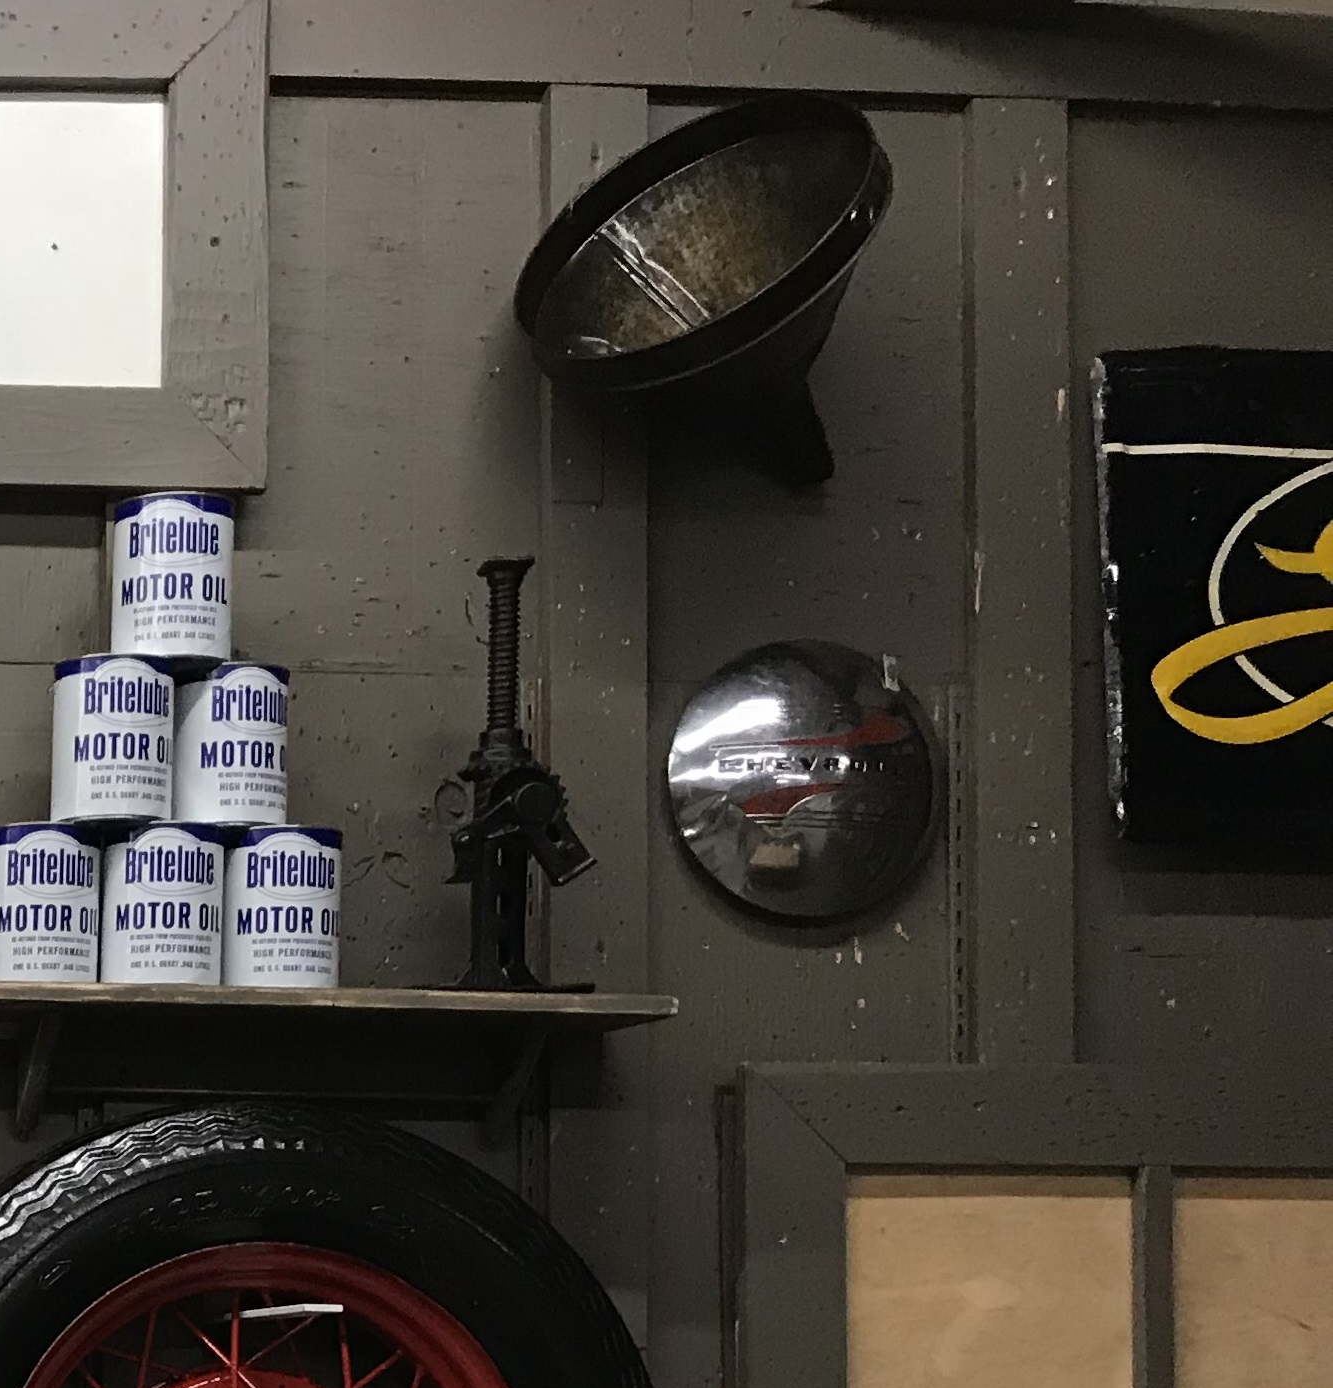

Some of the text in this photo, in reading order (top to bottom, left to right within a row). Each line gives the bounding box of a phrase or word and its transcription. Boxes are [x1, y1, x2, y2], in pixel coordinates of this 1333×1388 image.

[129, 516, 219, 559] Britelube
[121, 572, 227, 606] MOTOR OIL
[157, 614, 216, 627] PERFORMANCE
[84, 676, 169, 717] Britelube
[74, 732, 150, 763] MOTOR
[200, 740, 275, 769] MOTOR
[91, 775, 111, 785] HIGH
[219, 782, 240, 791] HIGH
[7, 848, 94, 888] Britelube
[125, 845, 214, 885] Britelube
[247, 850, 335, 890] Britelube
[79, 906, 98, 936] OIL
[115, 901, 220, 933] MOTOR OIL
[237, 906, 339, 938] MOTOR OIL
[12, 946, 33, 956] HIGH
[130, 943, 211, 956] HIGH PERFORMANCE
[253, 948, 274, 958] HIGH
